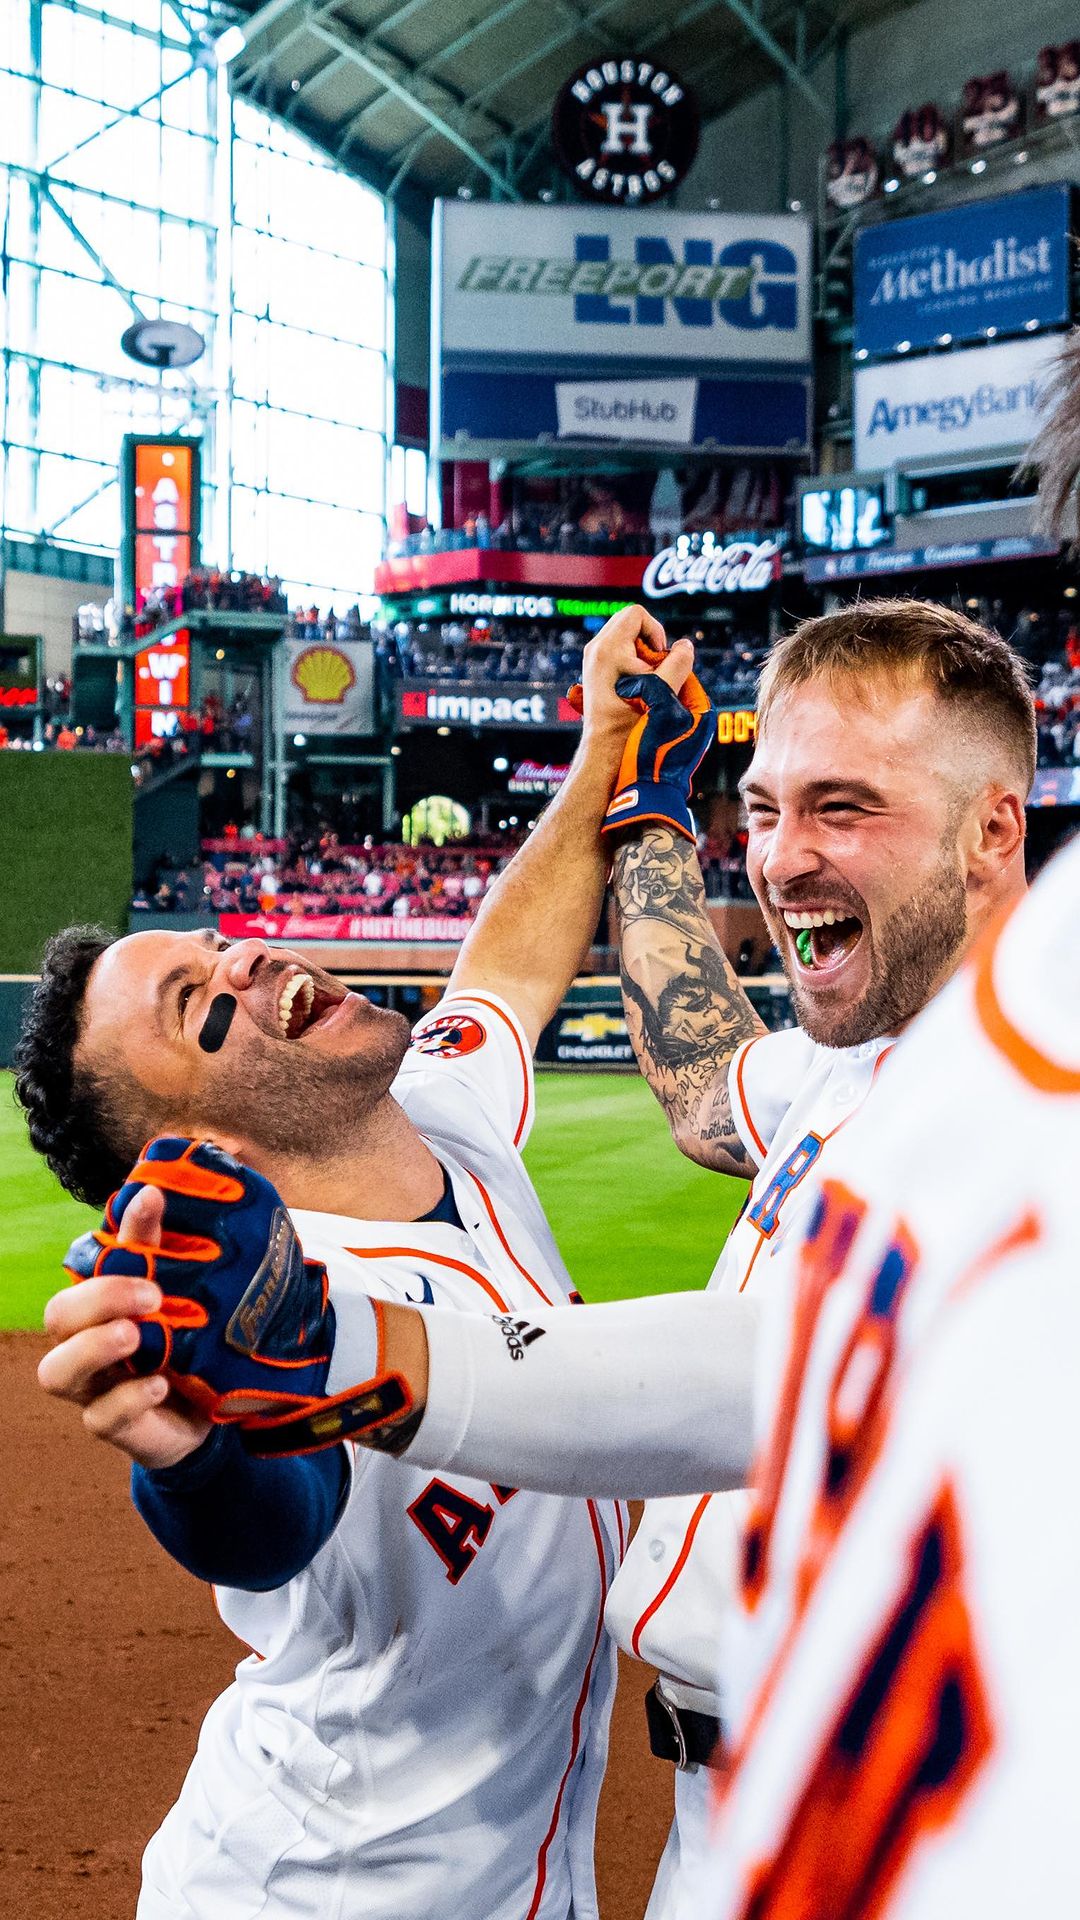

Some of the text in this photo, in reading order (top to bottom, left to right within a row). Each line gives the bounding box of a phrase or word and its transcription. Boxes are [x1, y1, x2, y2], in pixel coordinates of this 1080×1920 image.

[571, 60, 685, 106] HOUSTON
[601, 102, 653, 154] H
[575, 158, 677, 198] ASTROS
[456, 254, 753, 300] FREEPORT
[573, 234, 798, 331] LNG
[870, 237, 1050, 306] Methodist
[574, 396, 678, 425] StubHub
[427, 688, 545, 726] impact
[558, 1044, 633, 1059] CHEVROLET
